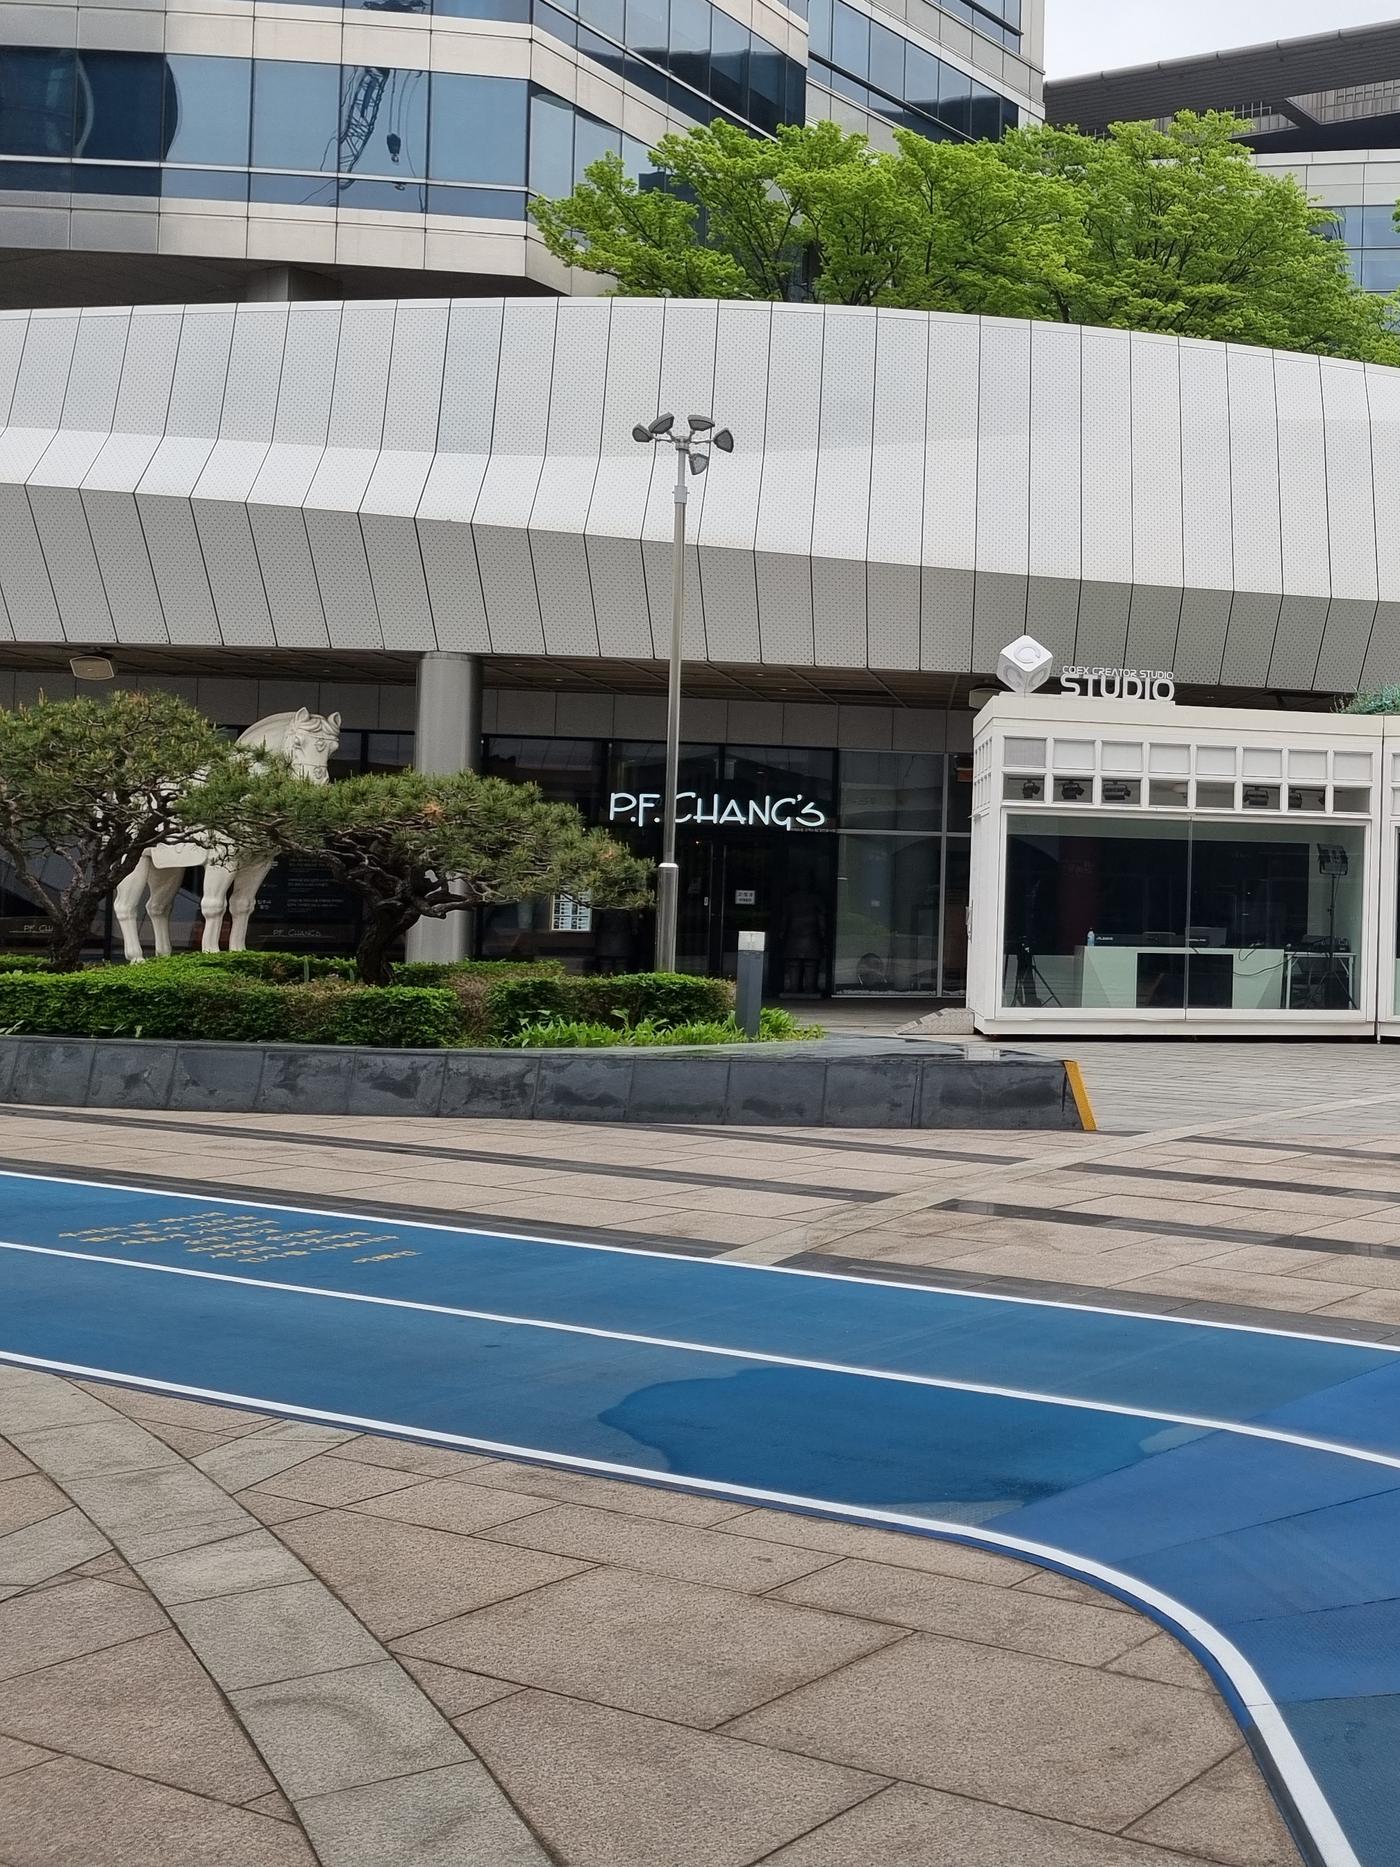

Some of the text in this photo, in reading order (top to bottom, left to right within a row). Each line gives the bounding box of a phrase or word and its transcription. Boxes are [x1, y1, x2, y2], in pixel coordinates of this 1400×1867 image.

[1062, 665, 1174, 680] COEX CREATOR STUDIO
[1060, 673, 1176, 701] STUDIO
[609, 791, 826, 832] P.F. CHANG'S
